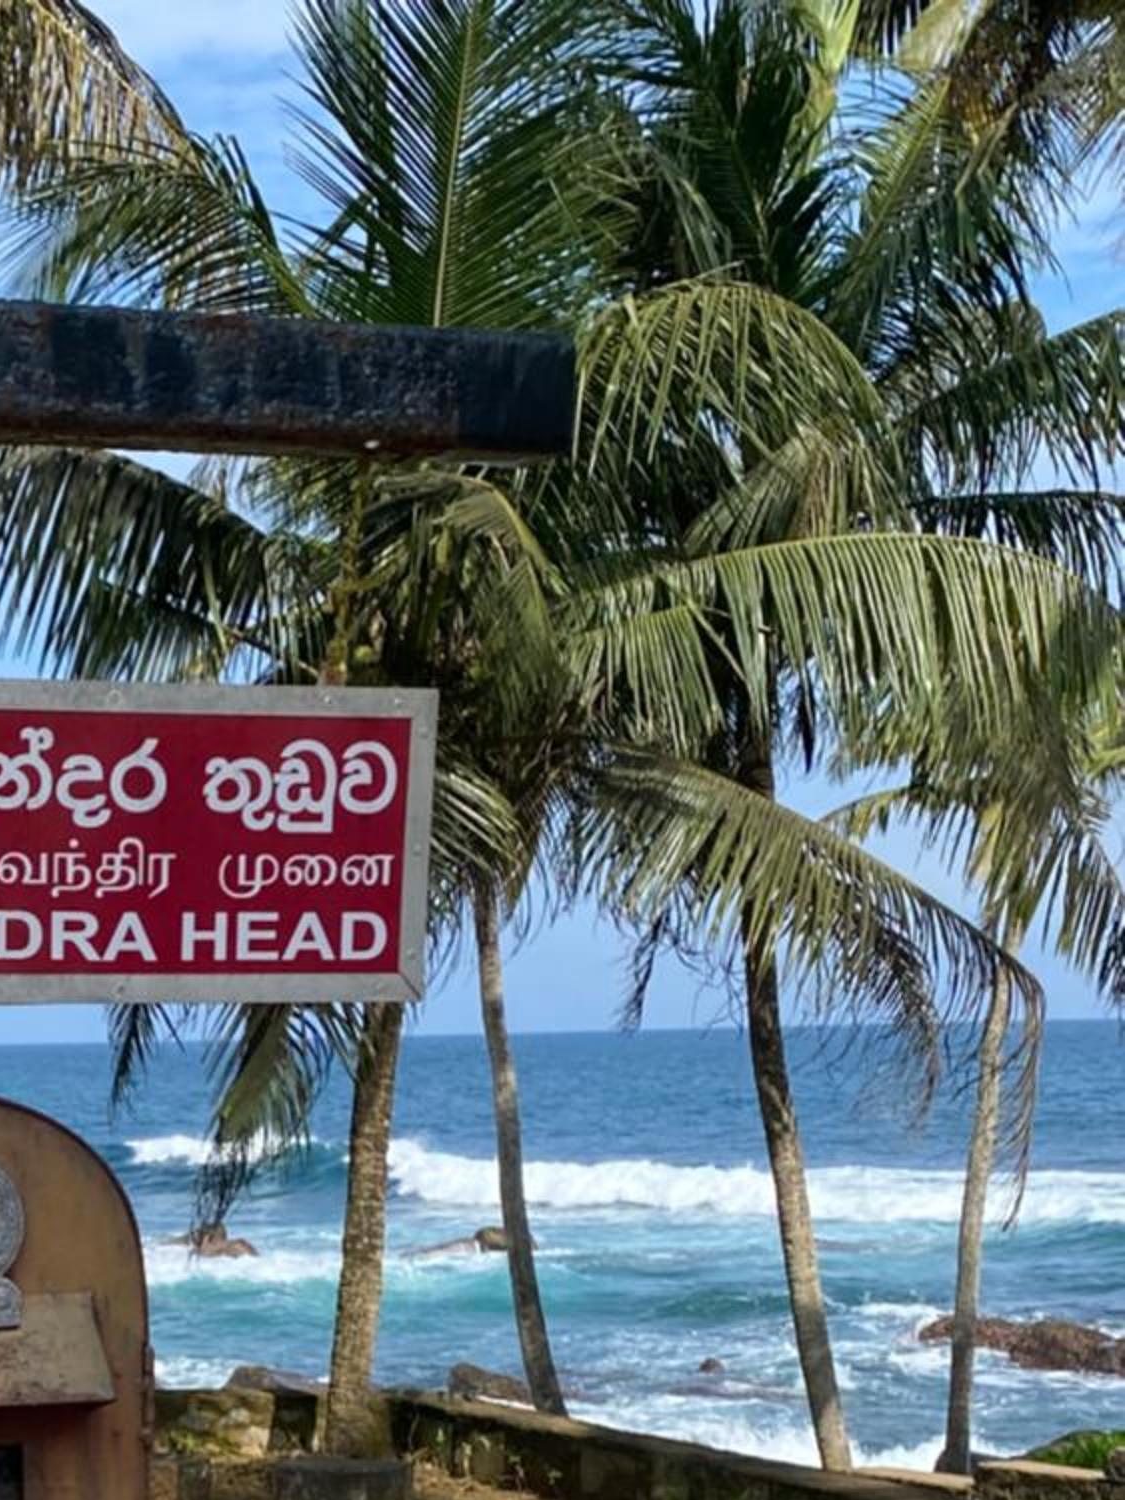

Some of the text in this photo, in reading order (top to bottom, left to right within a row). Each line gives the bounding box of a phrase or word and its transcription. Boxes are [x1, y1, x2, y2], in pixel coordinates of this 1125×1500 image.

[202, 738, 399, 834] තුඩුව
[218, 852, 395, 900] முனை
[180, 909, 388, 962] HEAD
